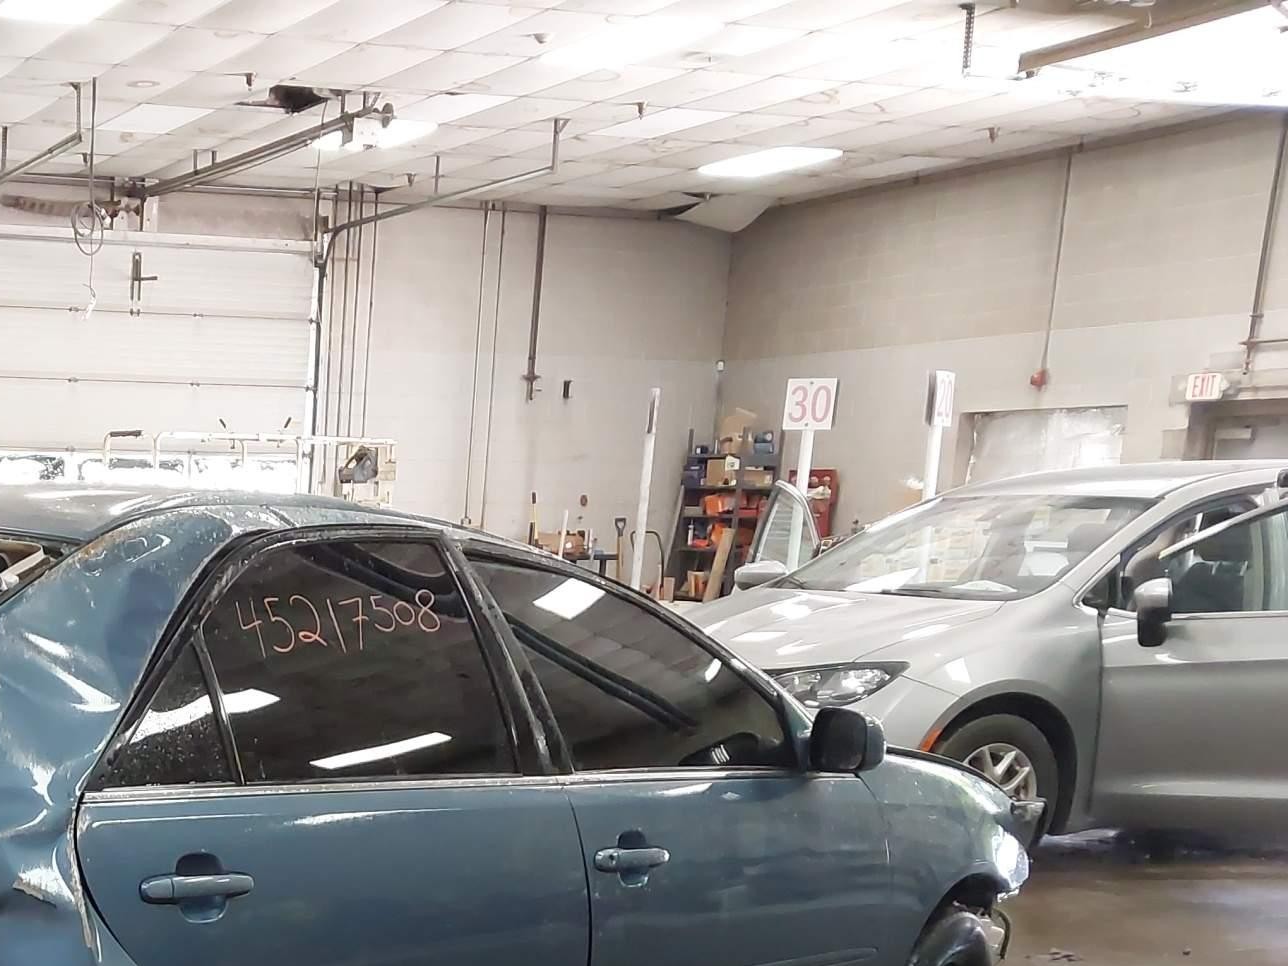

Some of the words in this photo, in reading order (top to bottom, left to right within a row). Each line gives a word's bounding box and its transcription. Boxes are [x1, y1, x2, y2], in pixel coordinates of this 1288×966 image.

[788, 385, 831, 423] 30
[1192, 374, 1217, 397] EXIT
[235, 588, 441, 658] 45217508
